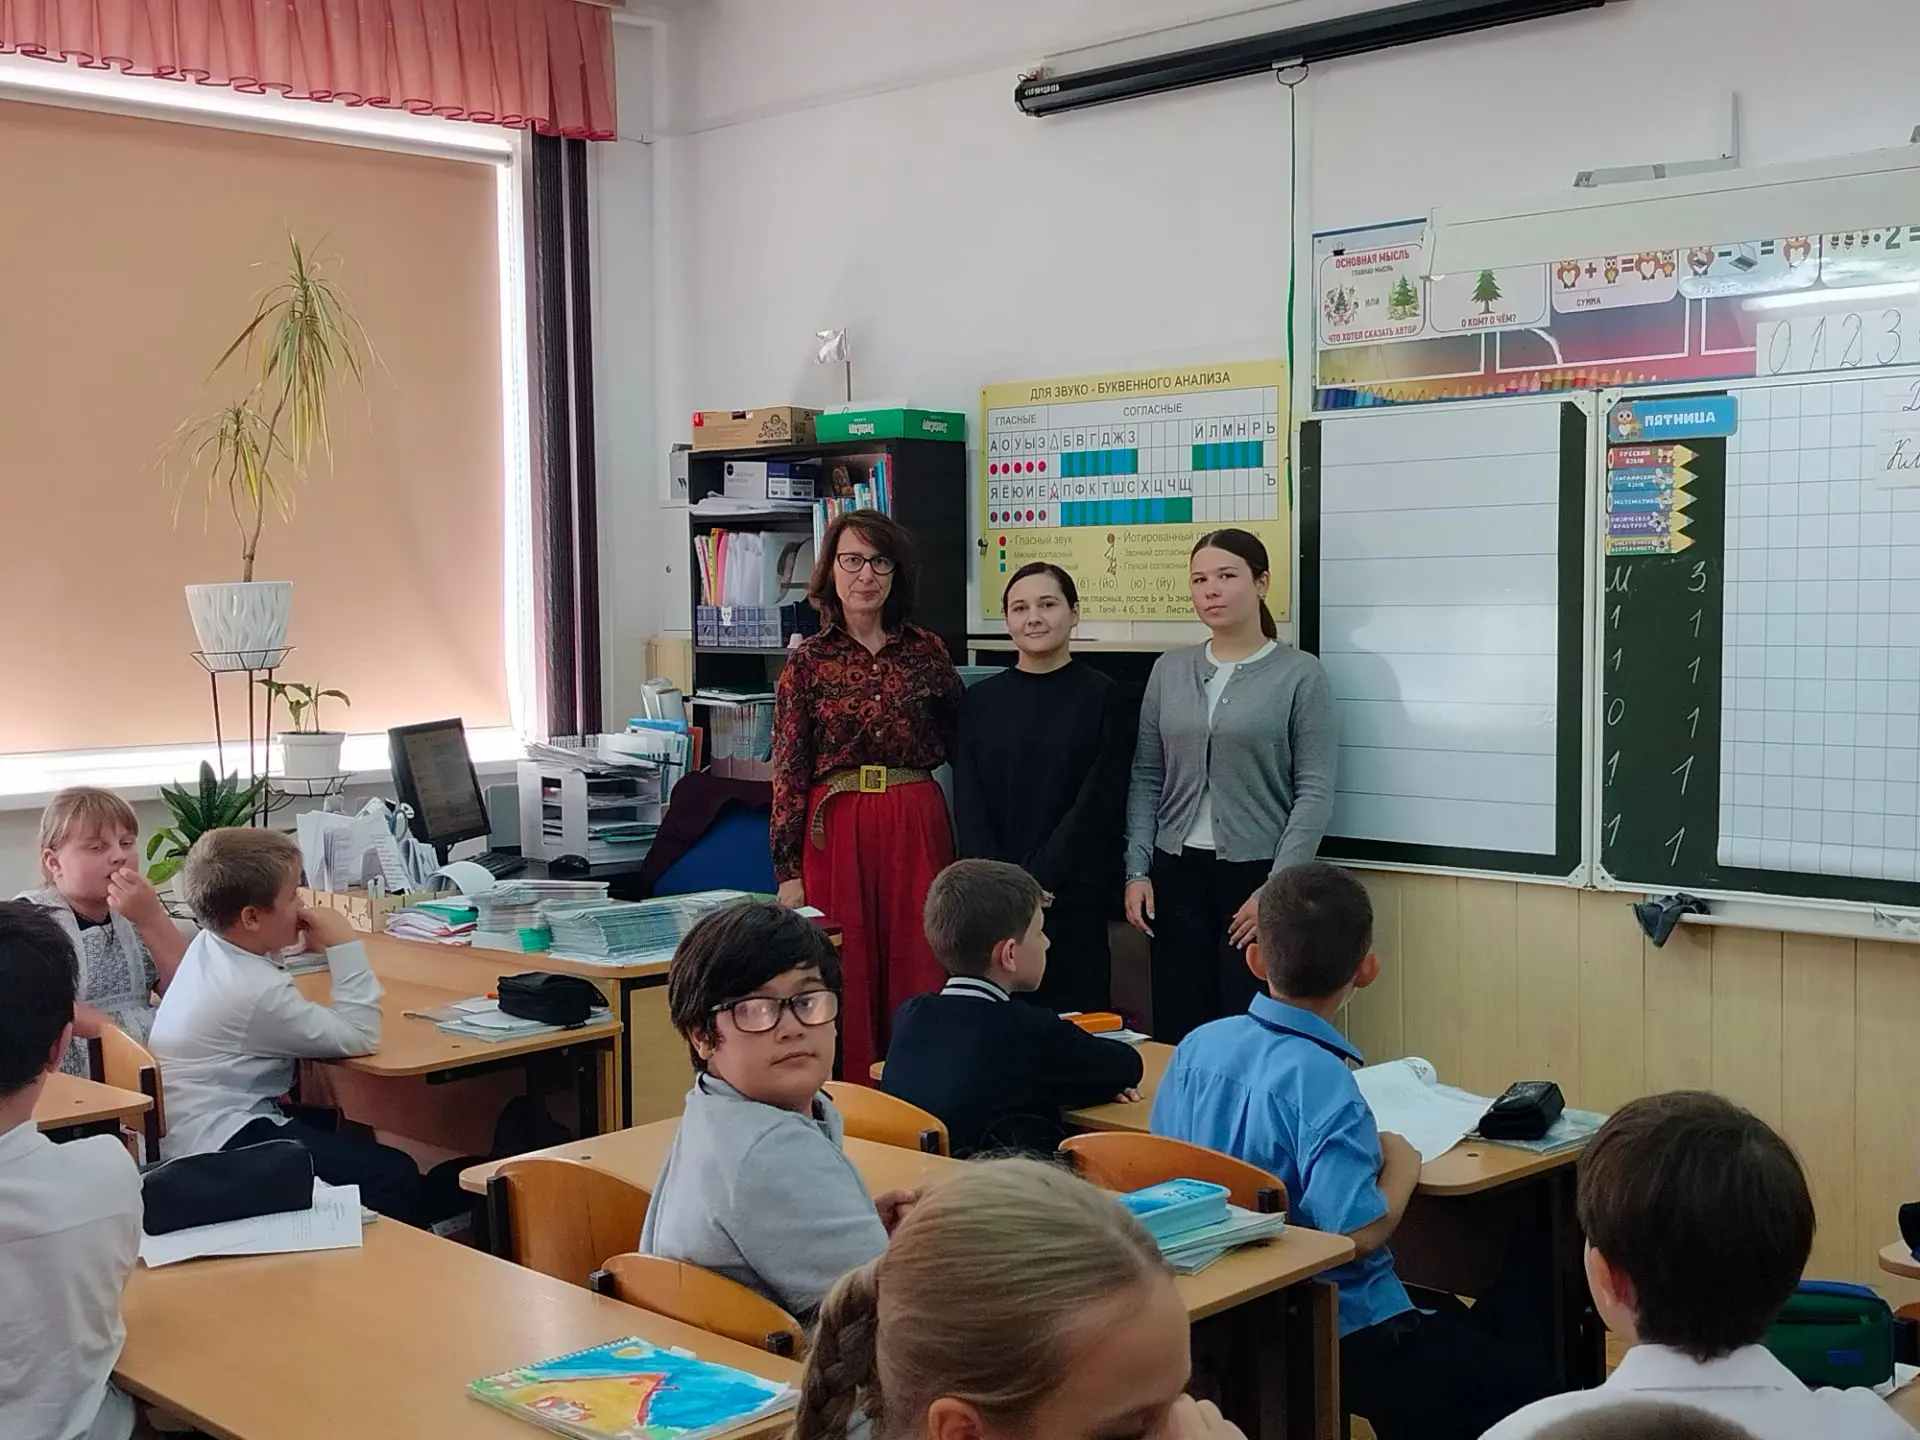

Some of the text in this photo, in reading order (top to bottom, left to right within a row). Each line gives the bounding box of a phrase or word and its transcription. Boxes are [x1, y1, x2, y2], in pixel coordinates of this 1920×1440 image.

[1335, 249, 1410, 269] ОСНОВНАЯ МЫСЛЬ
[1364, 296, 1380, 307] ИЛИ
[1576, 296, 1602, 307] СУММА
[1461, 313, 1517, 327] О КОМ? О ЧЁМ?
[1328, 325, 1418, 342] ЧТО ХОТЕЛ СКАЗАТЬ АВТОР
[1030, 387, 1052, 401] ДЛЯ
[1054, 384, 1089, 398] ЗВУКО
[1097, 376, 1171, 394] БУКВЕННОГО
[1174, 371, 1231, 388] АНАЛИЗА
[1123, 402, 1183, 417] СОГЛАСНЫЕ
[995, 414, 1037, 426] ГЛАСНЫЕ
[1643, 411, 1717, 428] ПЯТНИЦА
[990, 420, 1276, 452] А О У Ы Э Б В Г Д Ж З Й Л М Н Р Ь
[990, 473, 1276, 499] Я Ё Ю И Е П Ф К Т Ш С Х Ц Ч Щ Ъ
[1015, 533, 1073, 546] Гласный звук
[1123, 529, 1194, 544] Йотированный
